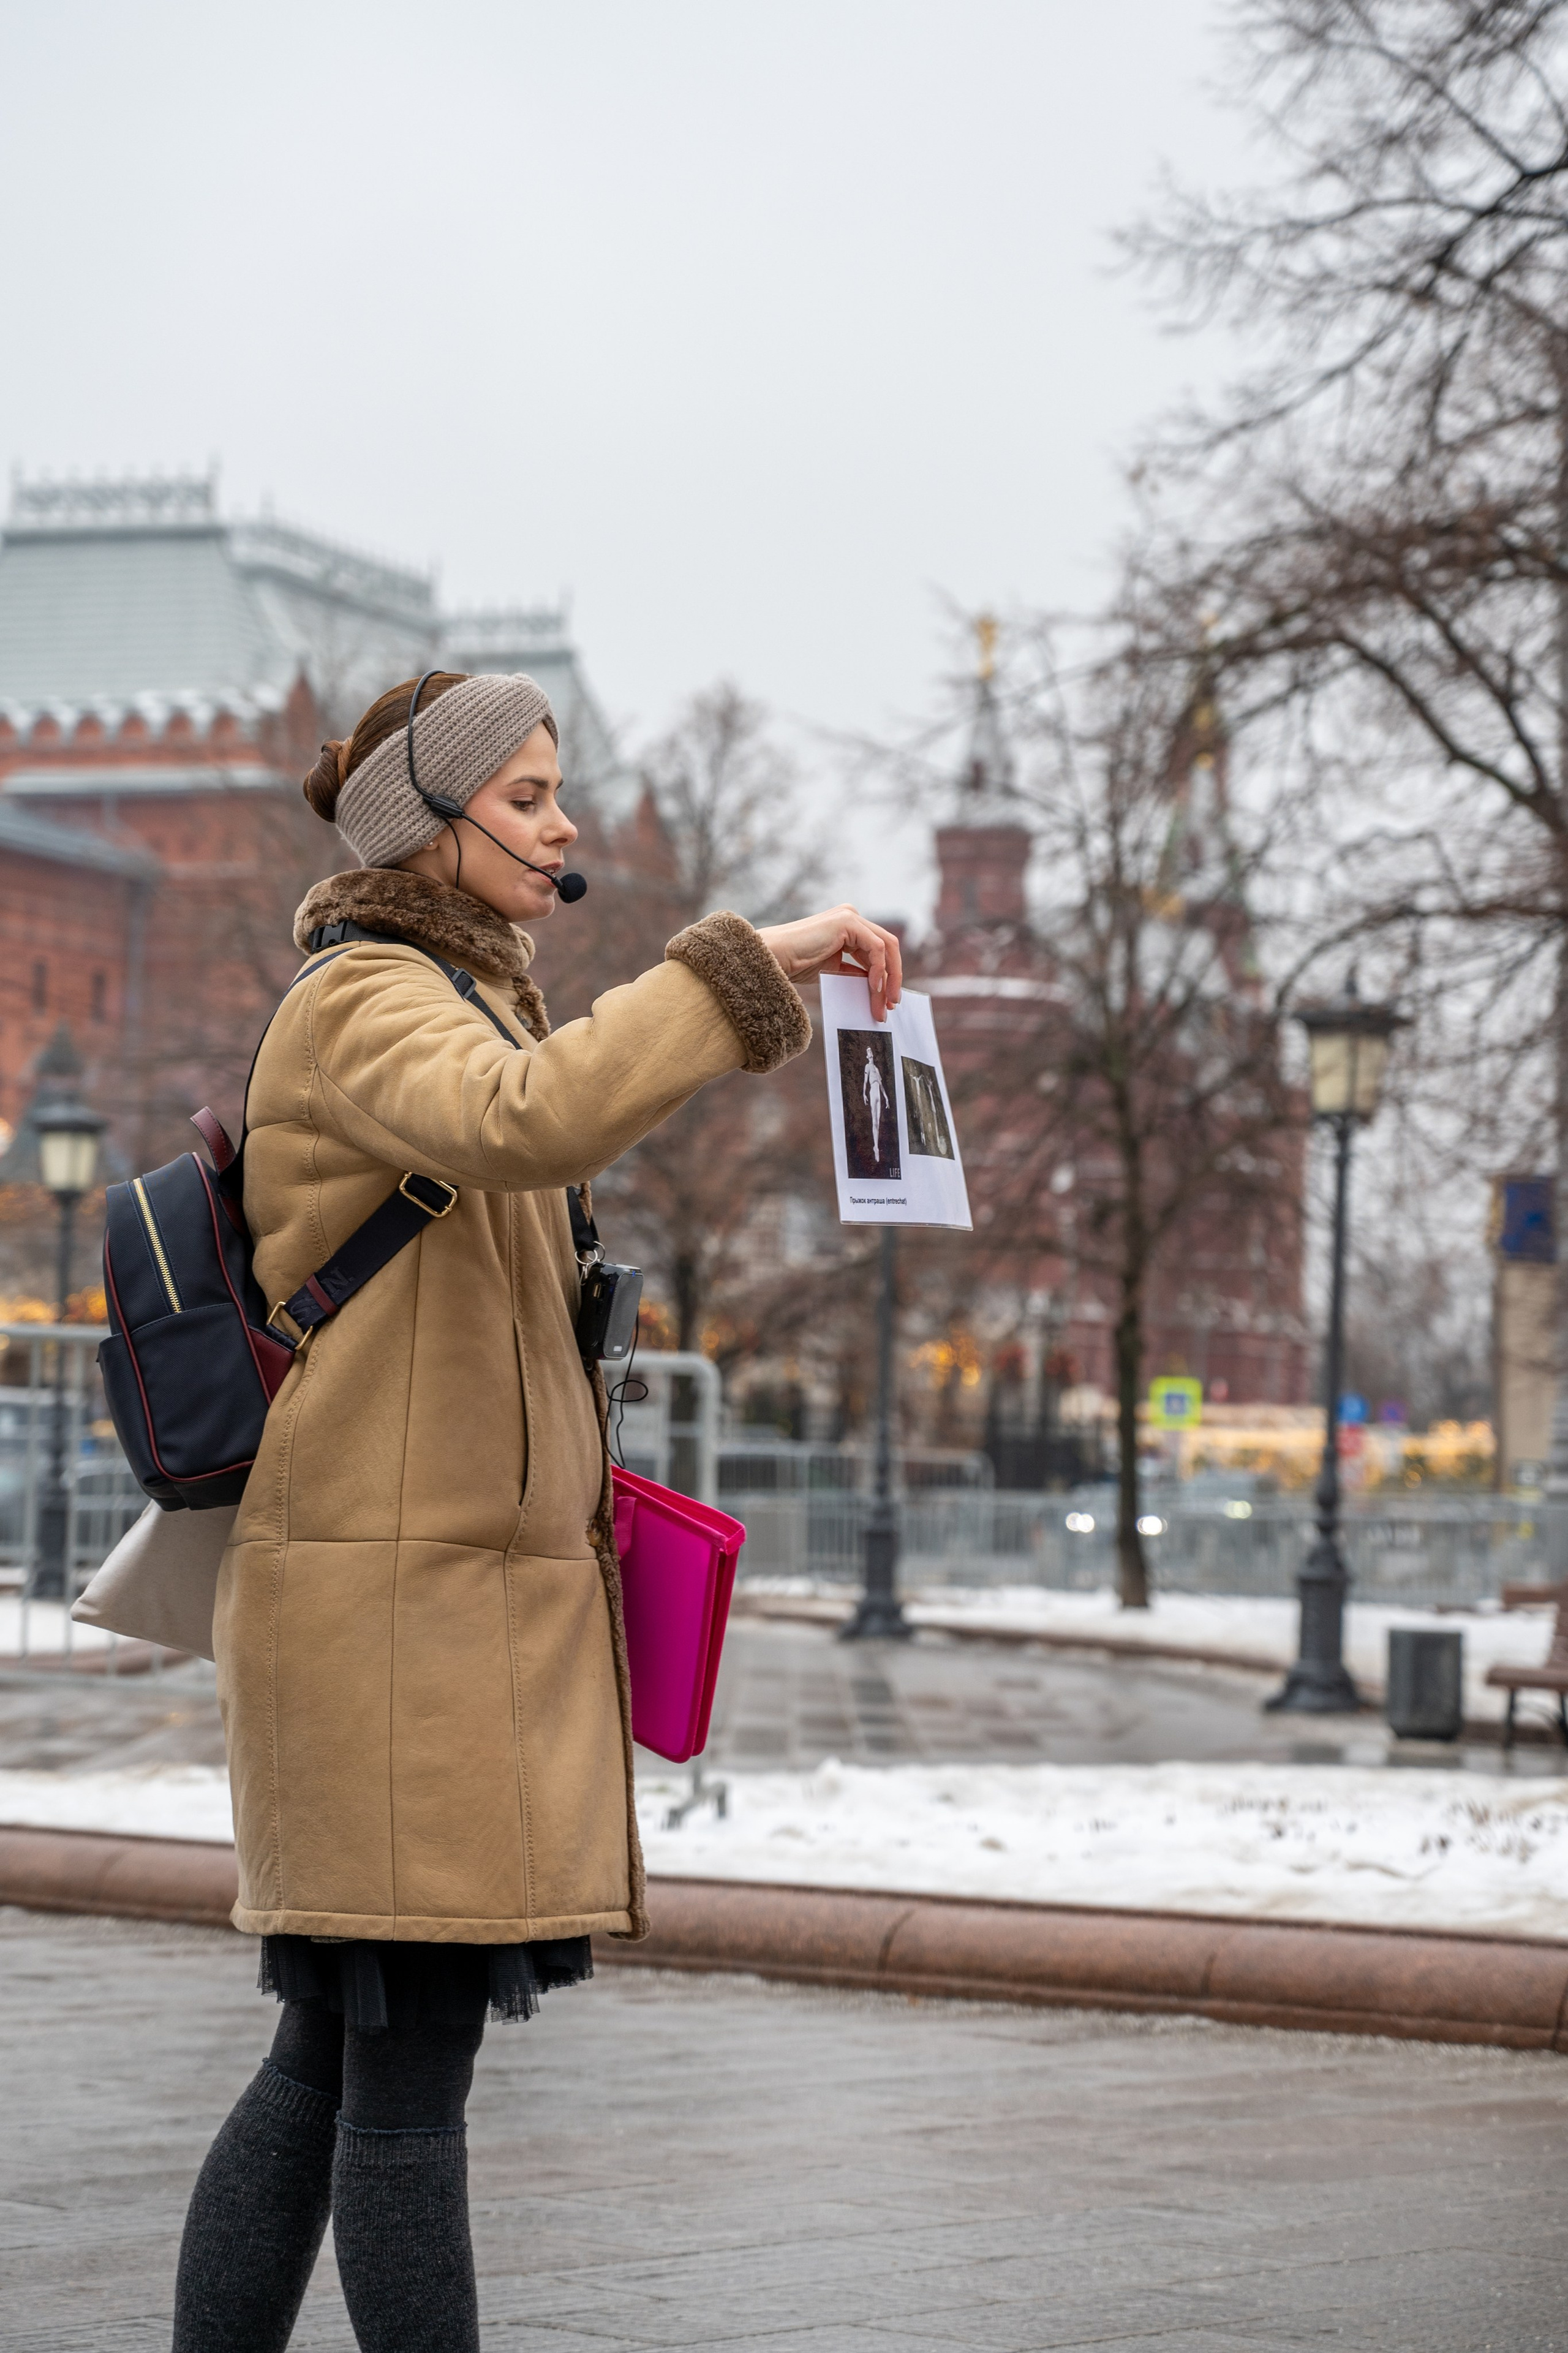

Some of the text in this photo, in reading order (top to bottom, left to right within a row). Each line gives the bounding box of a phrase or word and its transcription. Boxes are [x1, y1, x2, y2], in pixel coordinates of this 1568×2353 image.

[889, 1168, 900, 1177] LIFE
[850, 1196, 866, 1205] Прыжок
[886, 1197, 907, 1206] (entrechat)
